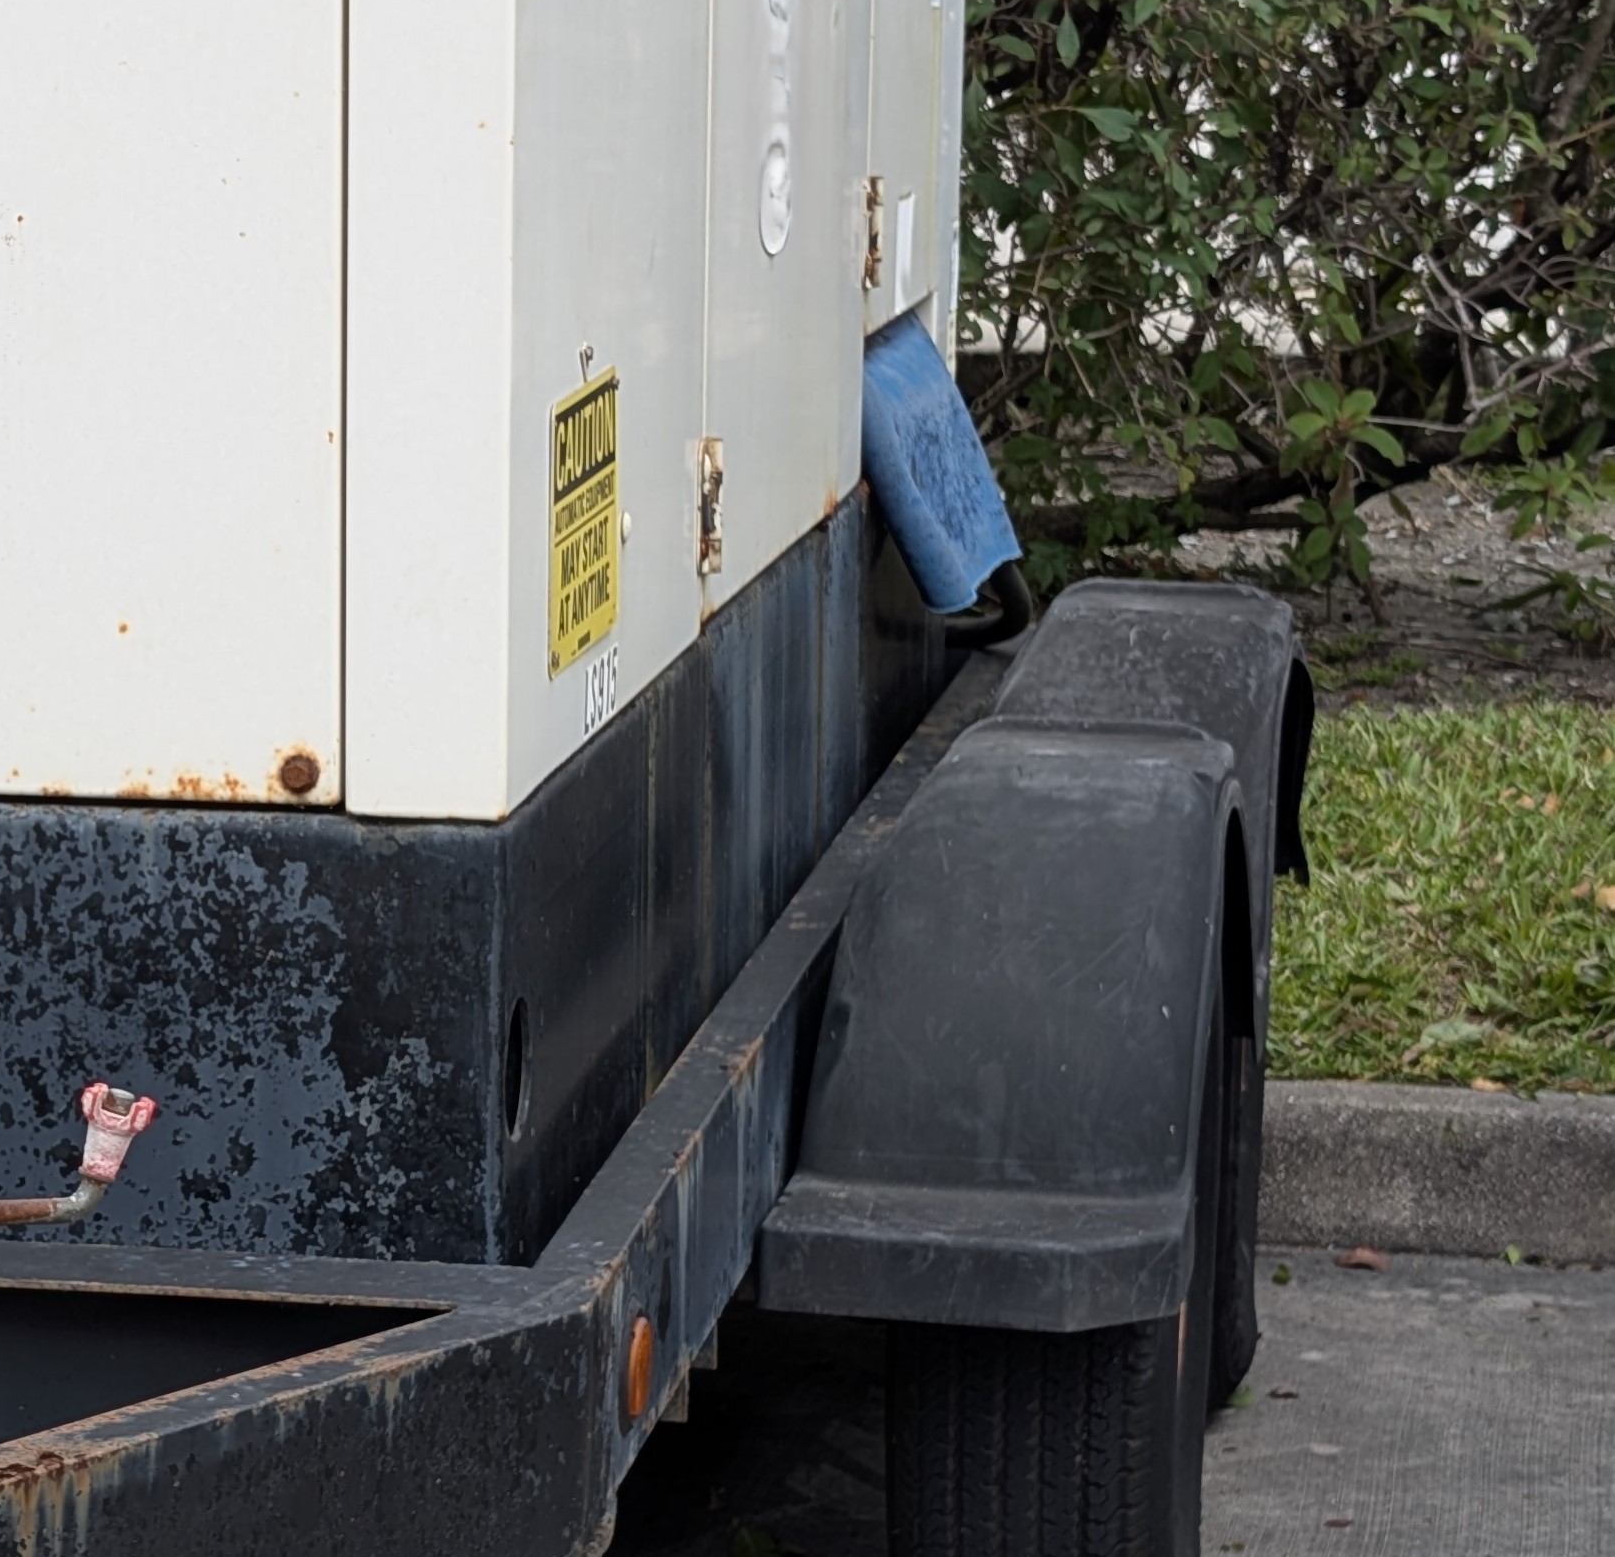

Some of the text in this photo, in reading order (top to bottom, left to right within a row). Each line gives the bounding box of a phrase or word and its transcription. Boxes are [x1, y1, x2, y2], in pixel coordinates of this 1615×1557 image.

[556, 388, 614, 492] CAUTION
[555, 469, 615, 536] AUTOMATIC EQUIPMENT
[561, 515, 609, 591] MAY START
[558, 562, 610, 641] AT ANYTIME
